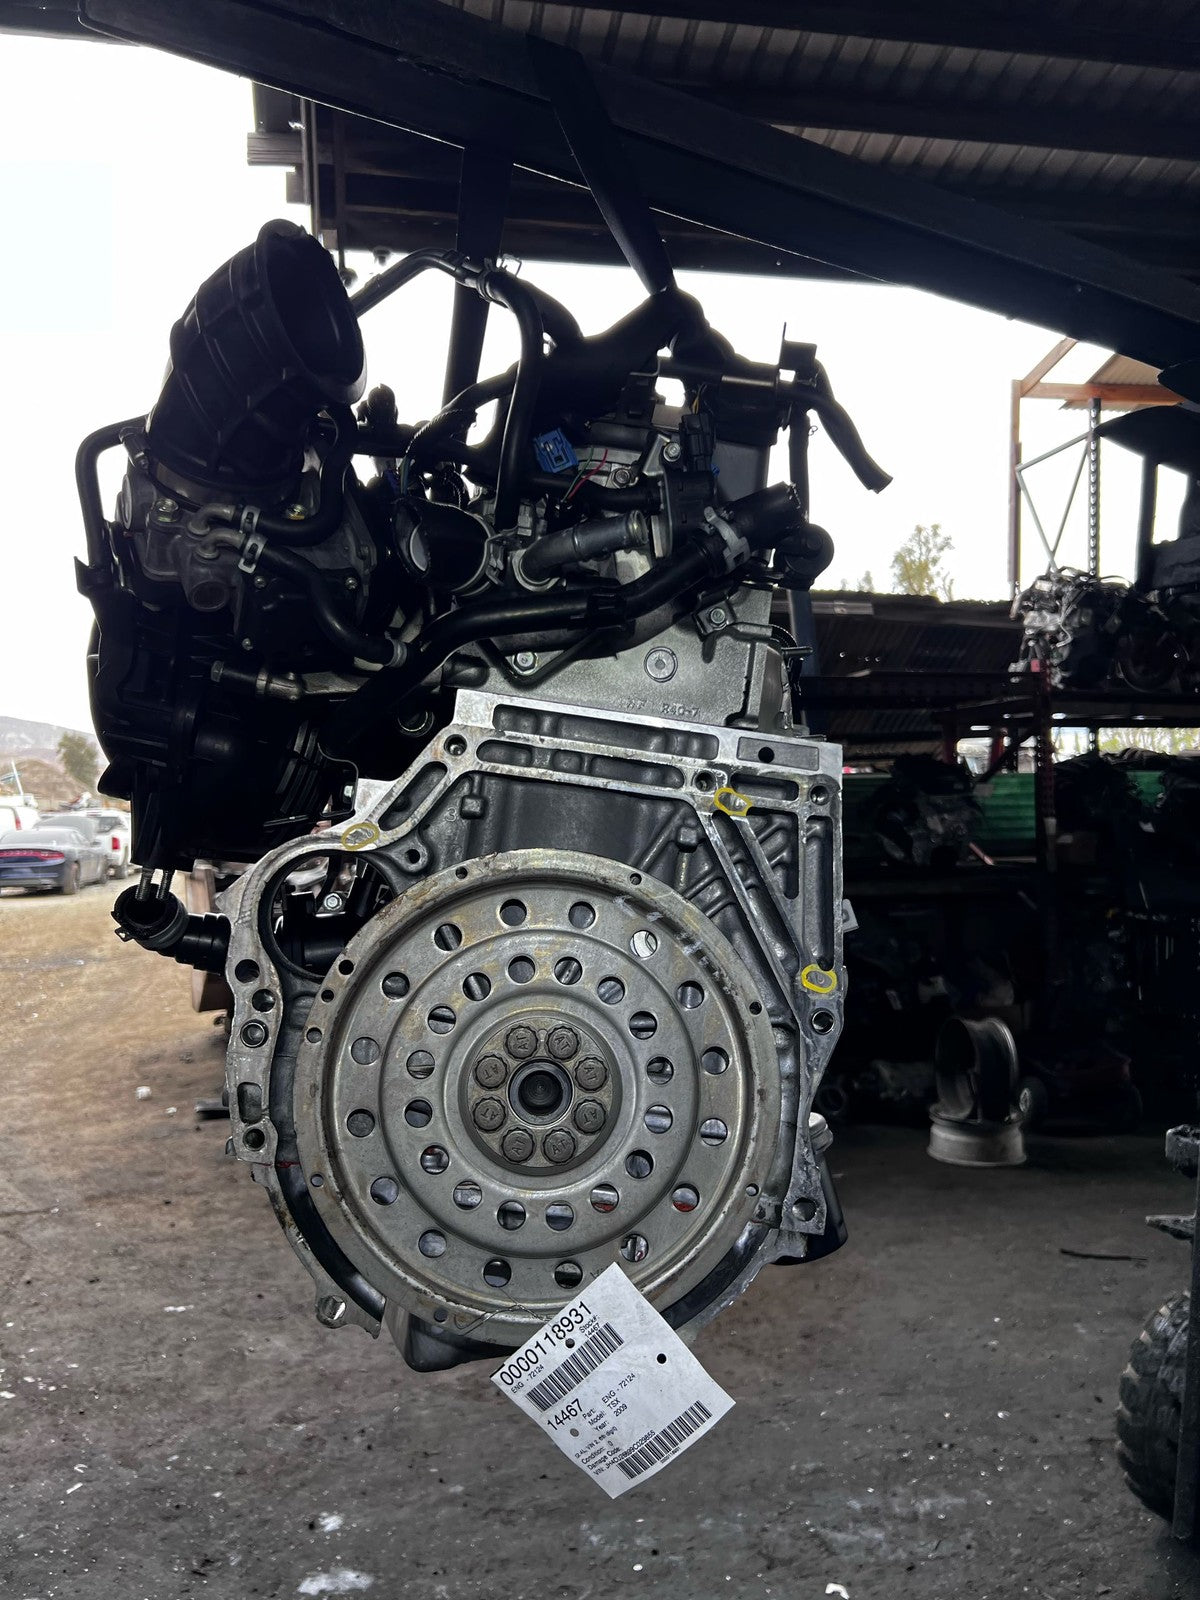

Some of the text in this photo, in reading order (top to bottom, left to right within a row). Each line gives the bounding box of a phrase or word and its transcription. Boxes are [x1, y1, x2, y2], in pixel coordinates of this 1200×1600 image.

[445, 807, 457, 822] 3
[579, 1314, 600, 1333] Stock#:
[584, 1322, 600, 1338] 14467
[499, 1301, 592, 1386] 0000118931
[510, 1381, 524, 1394] ENG
[528, 1364, 544, 1379] 72124
[582, 1408, 596, 1420] Part:
[601, 1390, 616, 1404] ENG
[618, 1373, 635, 1389] 72124
[547, 1398, 583, 1430] 14467
[588, 1397, 620, 1426] Model: TSX
[594, 1403, 627, 1431] Year: 2009
[586, 1455, 608, 1470] Damage
